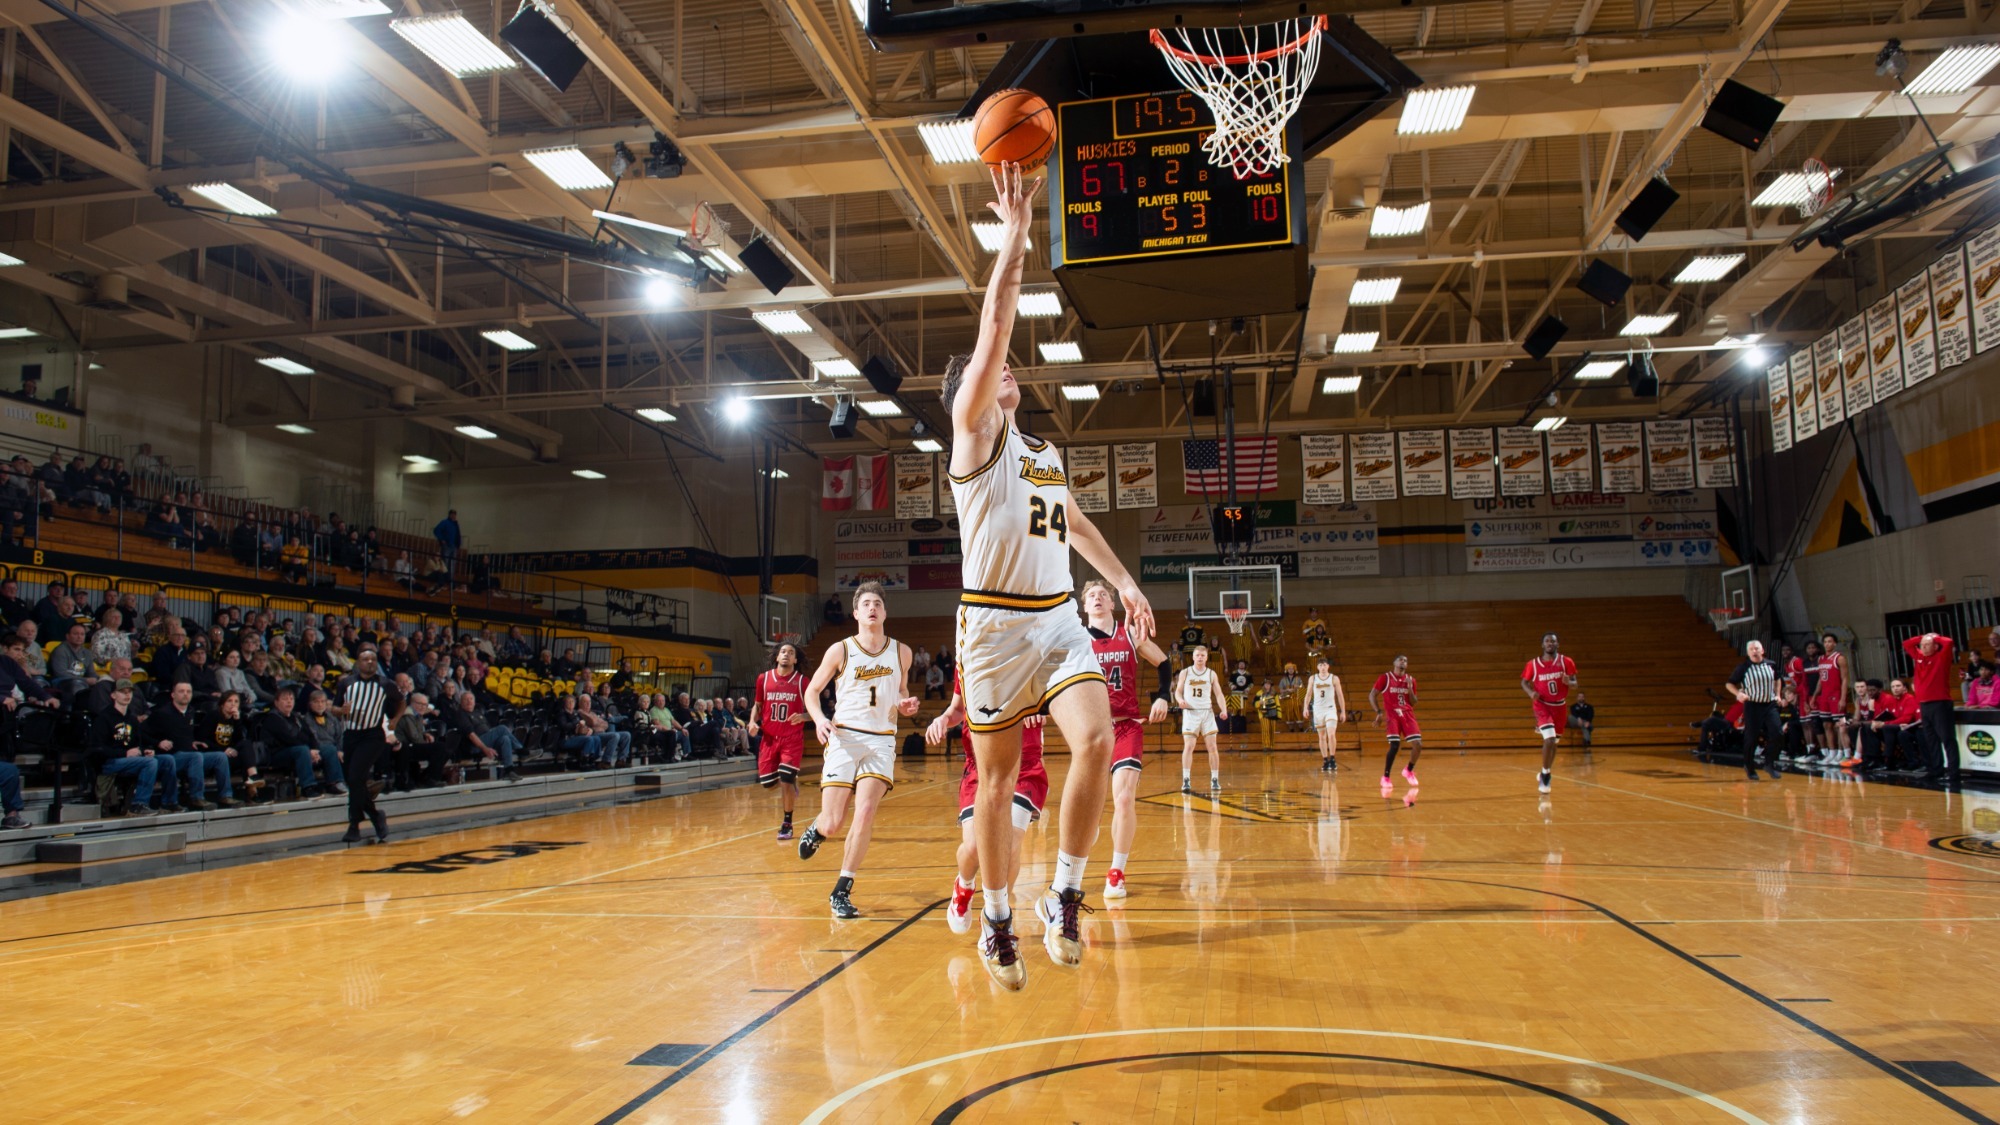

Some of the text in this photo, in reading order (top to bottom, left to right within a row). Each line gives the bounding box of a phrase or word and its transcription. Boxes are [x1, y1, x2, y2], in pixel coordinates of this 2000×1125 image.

[1135, 93, 1196, 128] 19.5
[1077, 139, 1137, 161] HUSKIES
[1151, 142, 1190, 157] PERIOD
[1082, 161, 1147, 196] 67 B
[1165, 159, 1208, 185] 2 B
[1247, 182, 1283, 198] FOULS
[1138, 189, 1212, 208] PLAYER FOUL
[1068, 200, 1103, 215] FOULS
[1253, 195, 1279, 223] 10
[1082, 213, 1098, 237] 9
[1161, 203, 1207, 232] 5 3
[1142, 234, 1208, 248] MICHIGAN TECH
[1403, 450, 1442, 469] Huskies
[1452, 451, 1492, 469] Huskies
[1650, 446, 1689, 464] Huskies
[1305, 461, 1341, 480] Huskies
[1354, 459, 1393, 477] Huskies
[1551, 491, 1625, 507] LAMERS
[1648, 497, 1698, 505] SUPERIOR
[1028, 494, 1067, 545] 24
[1485, 521, 1542, 532] SUPERIOR
[1576, 519, 1620, 529] ASPIRUS
[1655, 519, 1711, 531] Domino's
[854, 521, 905, 536] INSIGHT
[1253, 528, 1295, 545] LTIER
[1148, 532, 1210, 544] KEWEENAW
[33, 549, 44, 565] B
[837, 549, 904, 561] incrediblebank
[1222, 554, 1293, 566] CNTURY 21
[1482, 558, 1545, 567] MAGNUSON
[451, 604, 458, 616] C
[1095, 650, 1130, 665] ENPORT
[853, 664, 893, 682] Huskies
[1191, 688, 1202, 698] 13
[1320, 690, 1325, 698] 3
[1547, 680, 1558, 695] 0
[766, 692, 798, 702] DAVENPORT
[869, 685, 877, 707] 1
[770, 702, 788, 722] 10
